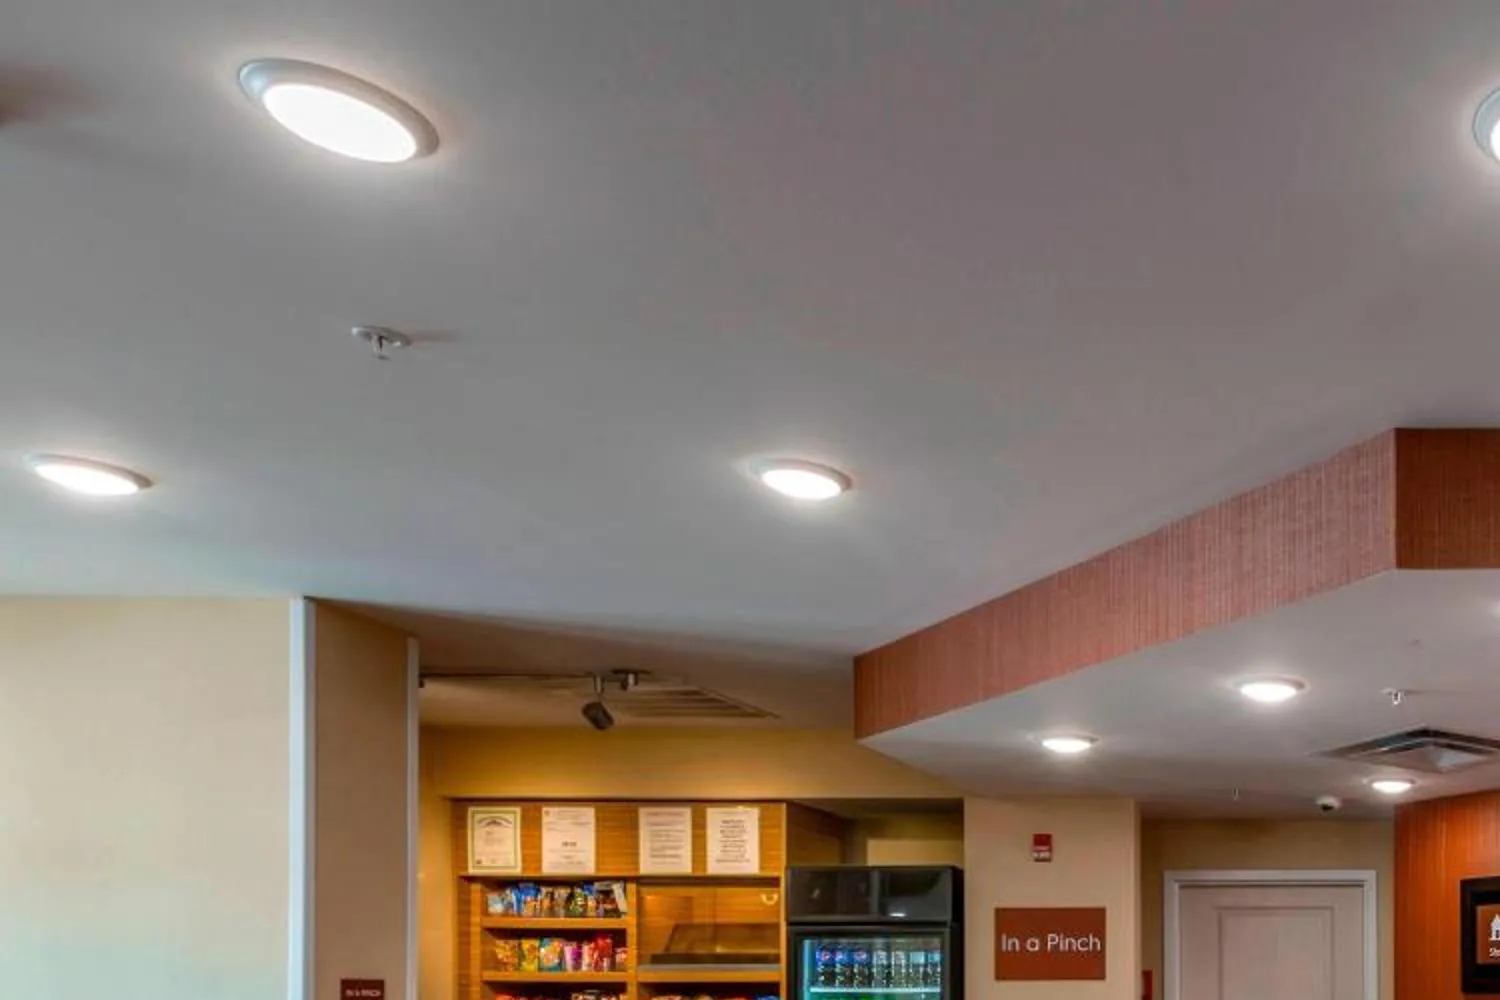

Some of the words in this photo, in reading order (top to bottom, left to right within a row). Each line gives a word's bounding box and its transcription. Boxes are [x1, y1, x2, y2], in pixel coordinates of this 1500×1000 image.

[1001, 933, 1019, 952] In
[1026, 937, 1039, 951] a
[1047, 933, 1101, 952] Pinch
